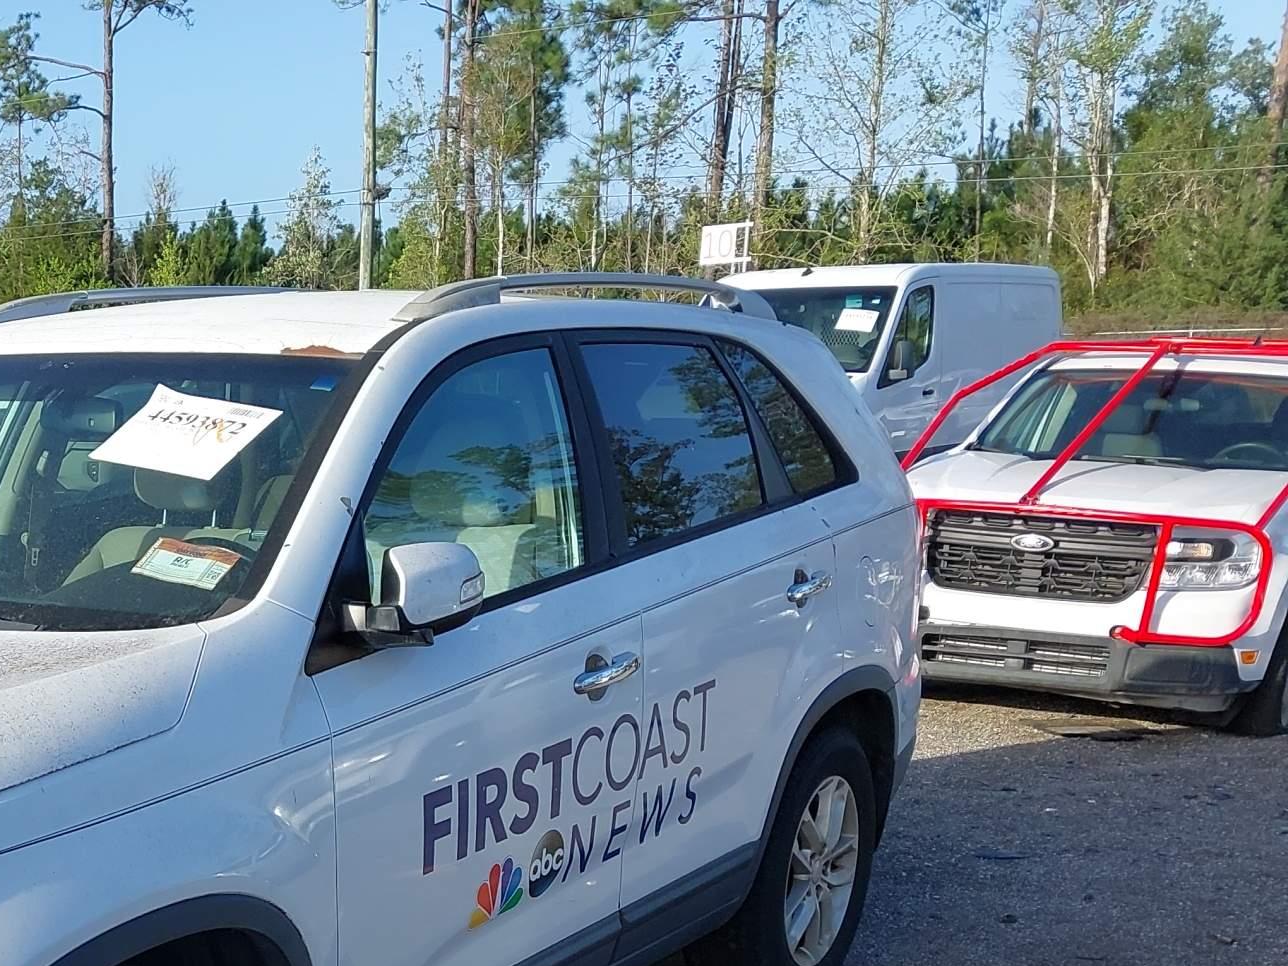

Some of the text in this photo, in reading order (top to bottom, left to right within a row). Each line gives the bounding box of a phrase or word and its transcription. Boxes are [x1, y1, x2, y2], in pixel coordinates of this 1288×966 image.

[703, 229, 733, 259] 10
[147, 408, 248, 436] 44593872
[422, 679, 717, 875] FIRSTCOAST
[561, 766, 702, 883] NEWS
[529, 846, 564, 882] abc
